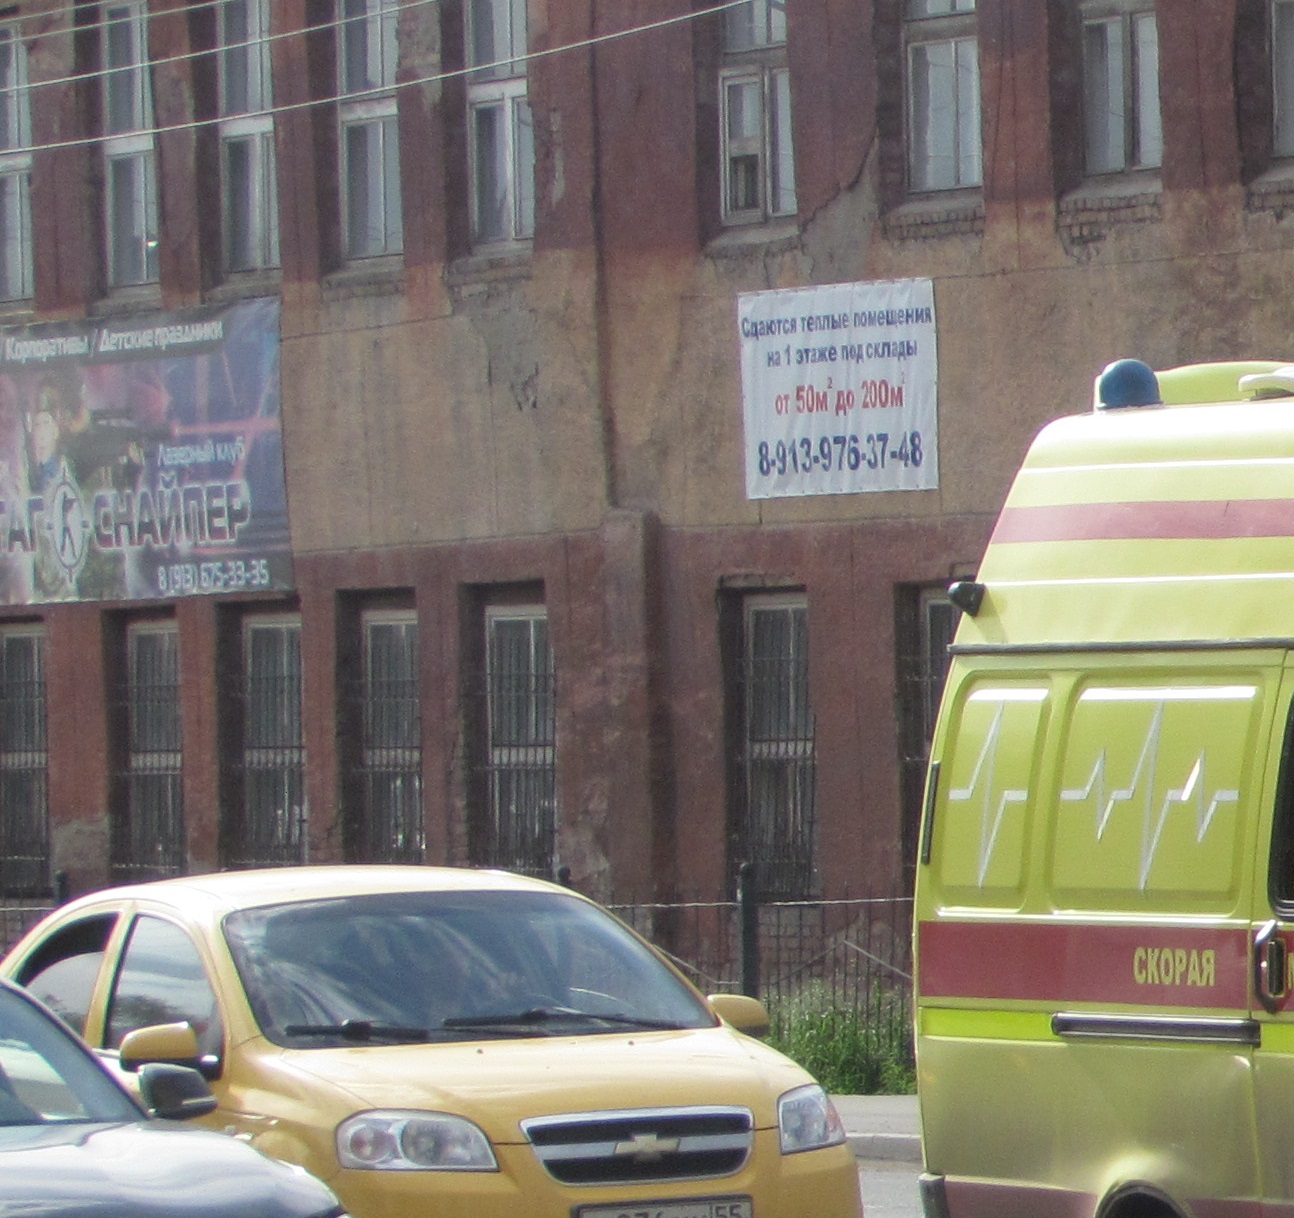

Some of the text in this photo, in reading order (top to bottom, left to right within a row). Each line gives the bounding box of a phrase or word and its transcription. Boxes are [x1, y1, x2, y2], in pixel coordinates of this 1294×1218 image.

[741, 306, 932, 340] Сдаются теплые помещения
[767, 339, 918, 367] на 1 этаже под склады
[775, 393, 790, 415] от
[835, 389, 855, 416] до
[758, 430, 923, 476] 8-913-976-37-48
[0, 496, 44, 554] АГ
[93, 471, 250, 549] СНАЙПЕР
[1133, 947, 1215, 987] СКОРАЯ
